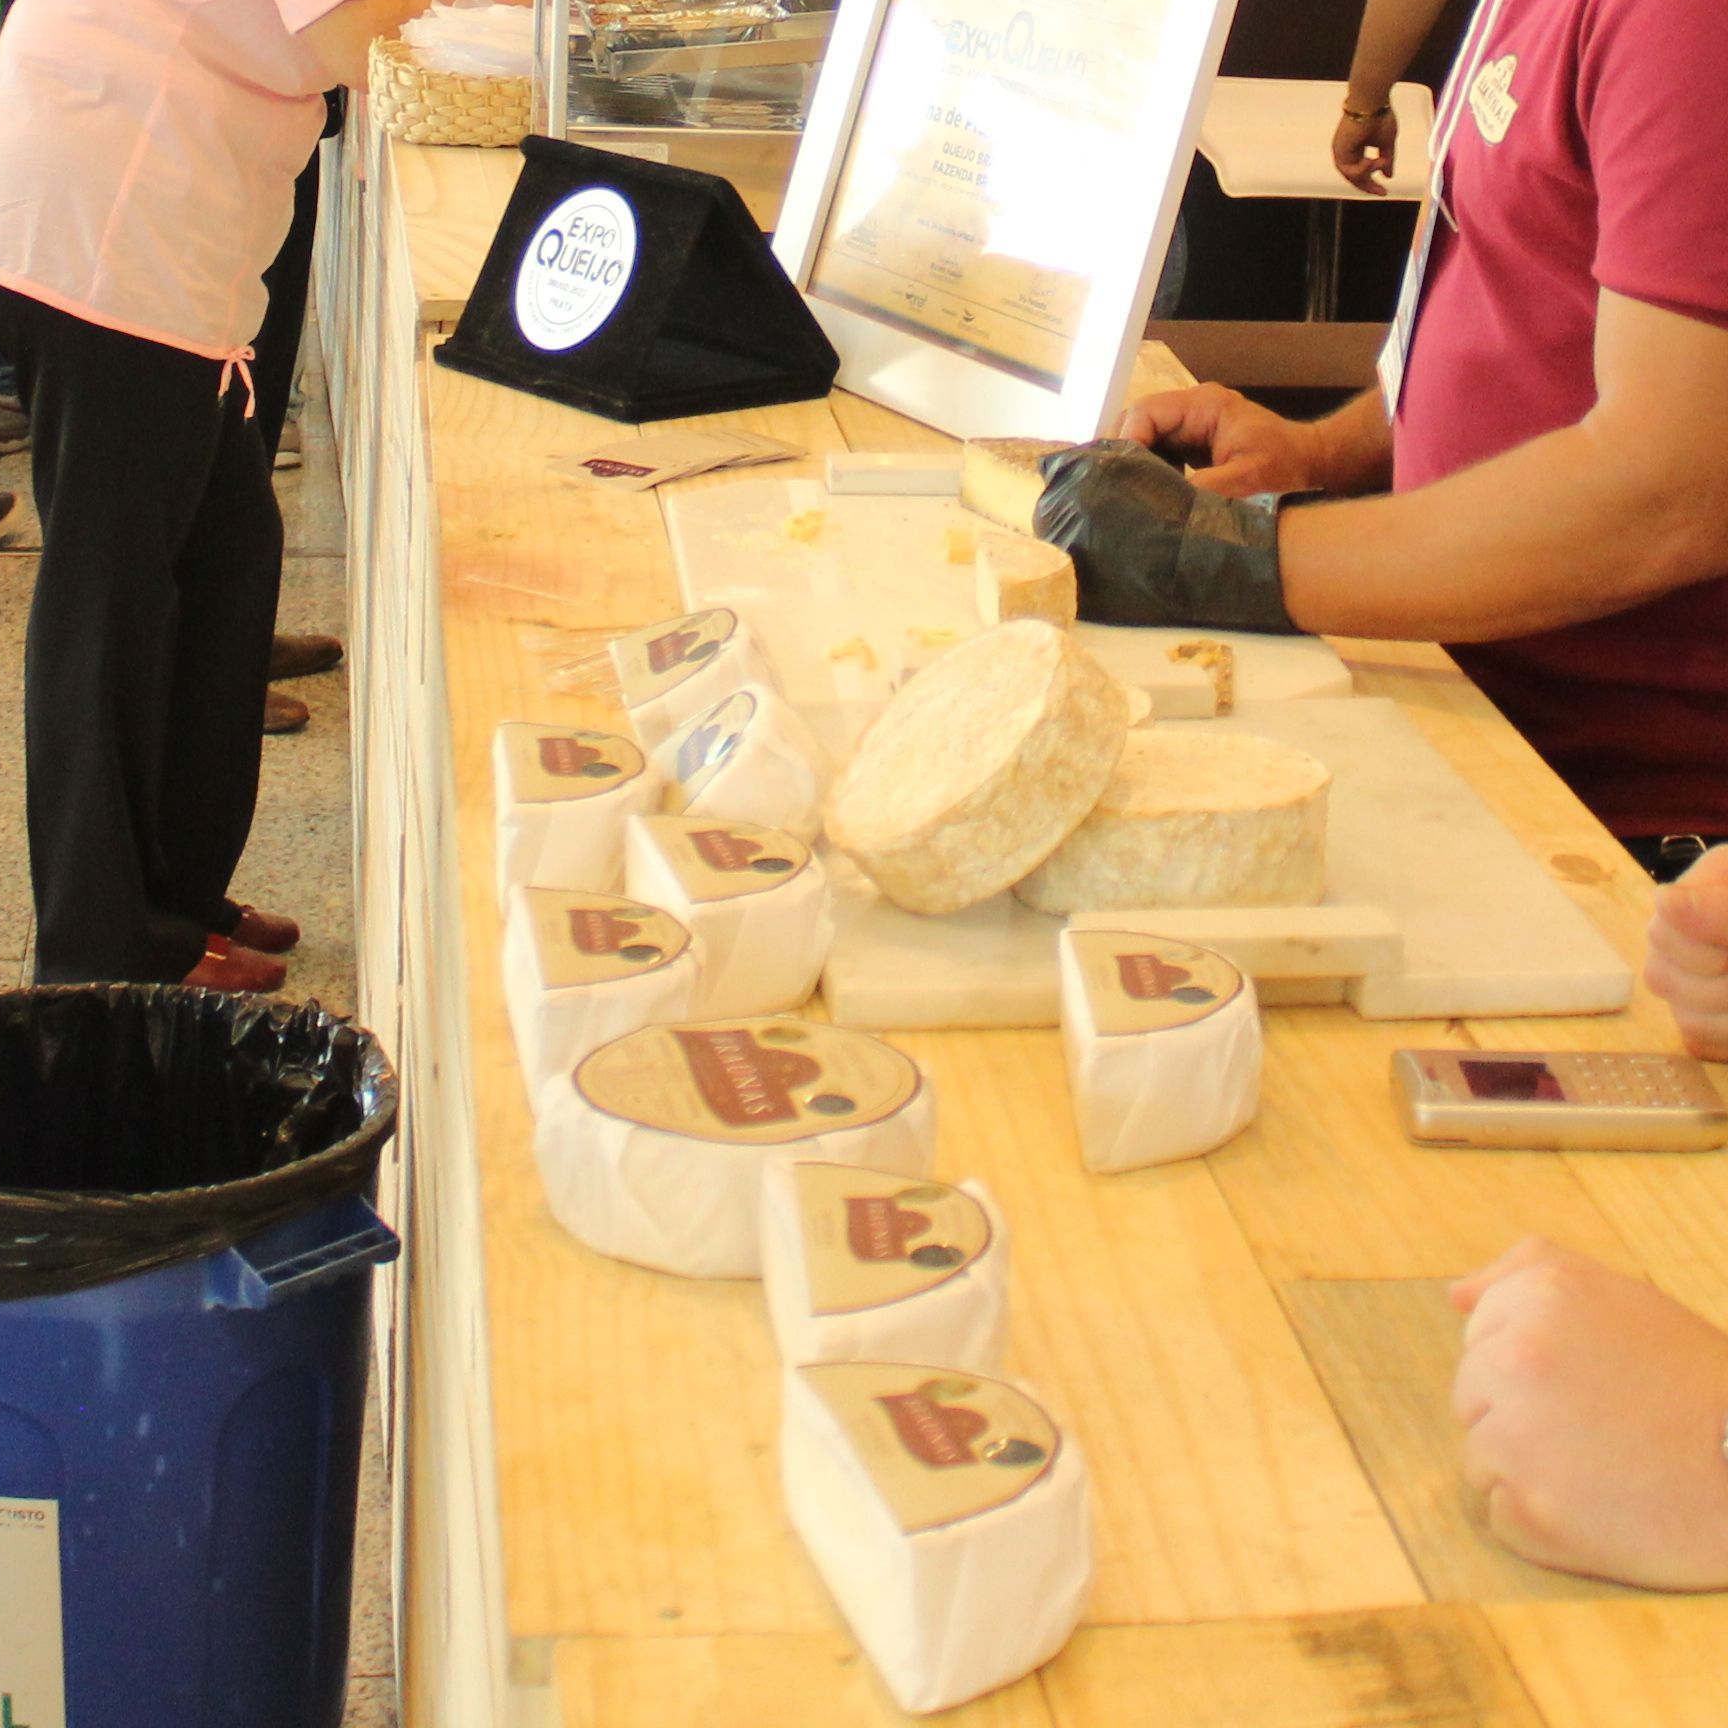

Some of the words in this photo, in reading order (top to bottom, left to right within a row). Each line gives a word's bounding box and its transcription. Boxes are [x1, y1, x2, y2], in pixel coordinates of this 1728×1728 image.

[942, 141, 976, 163] QUEIJO
[932, 159, 974, 185] FAZENDA
[566, 215, 617, 249] EXPO
[535, 228, 624, 287] QUEIJO
